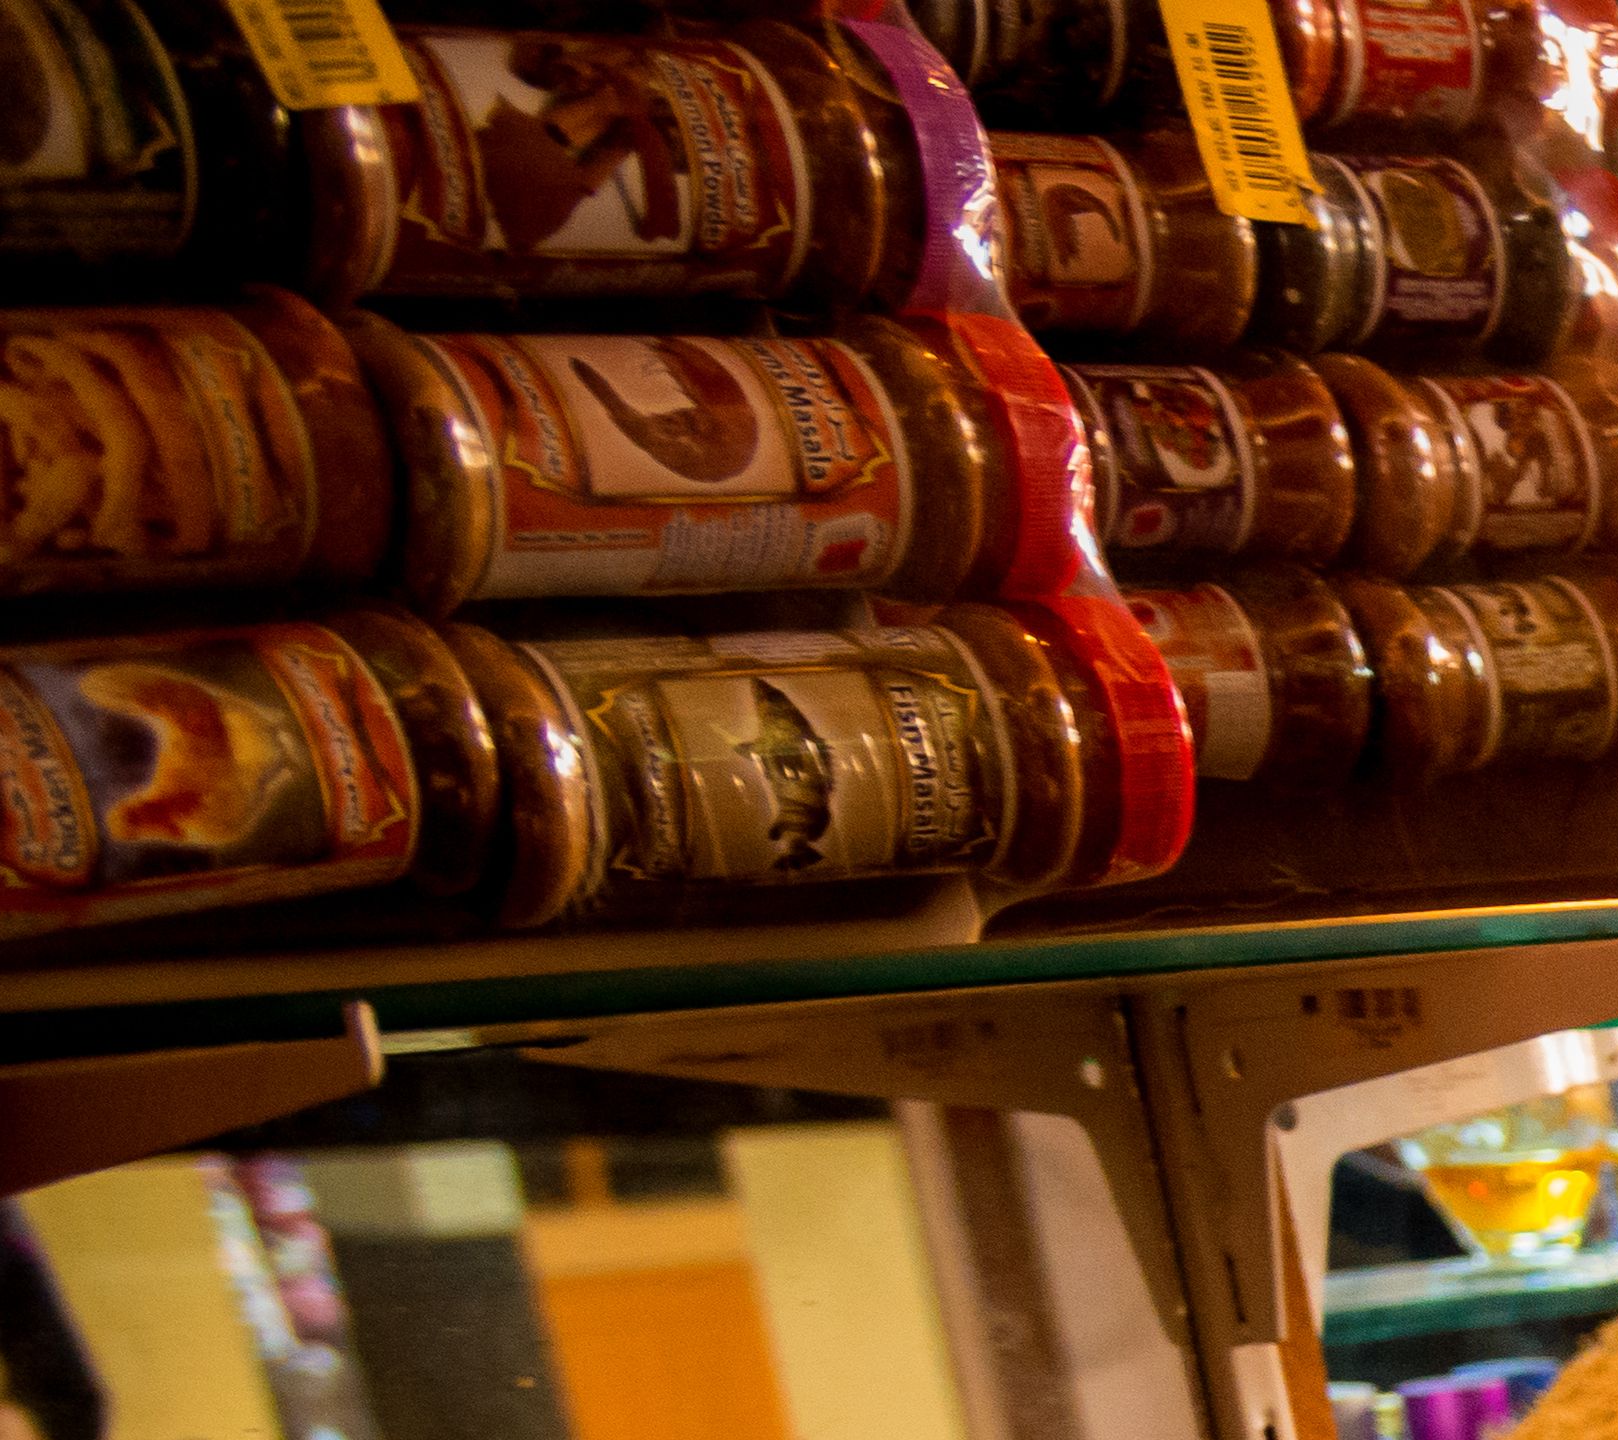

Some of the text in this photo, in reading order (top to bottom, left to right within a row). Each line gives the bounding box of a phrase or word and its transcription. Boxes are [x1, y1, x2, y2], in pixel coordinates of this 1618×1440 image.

[702, 160, 726, 248] Powder
[781, 385, 834, 481] Masala
[909, 751, 940, 848] Masala
